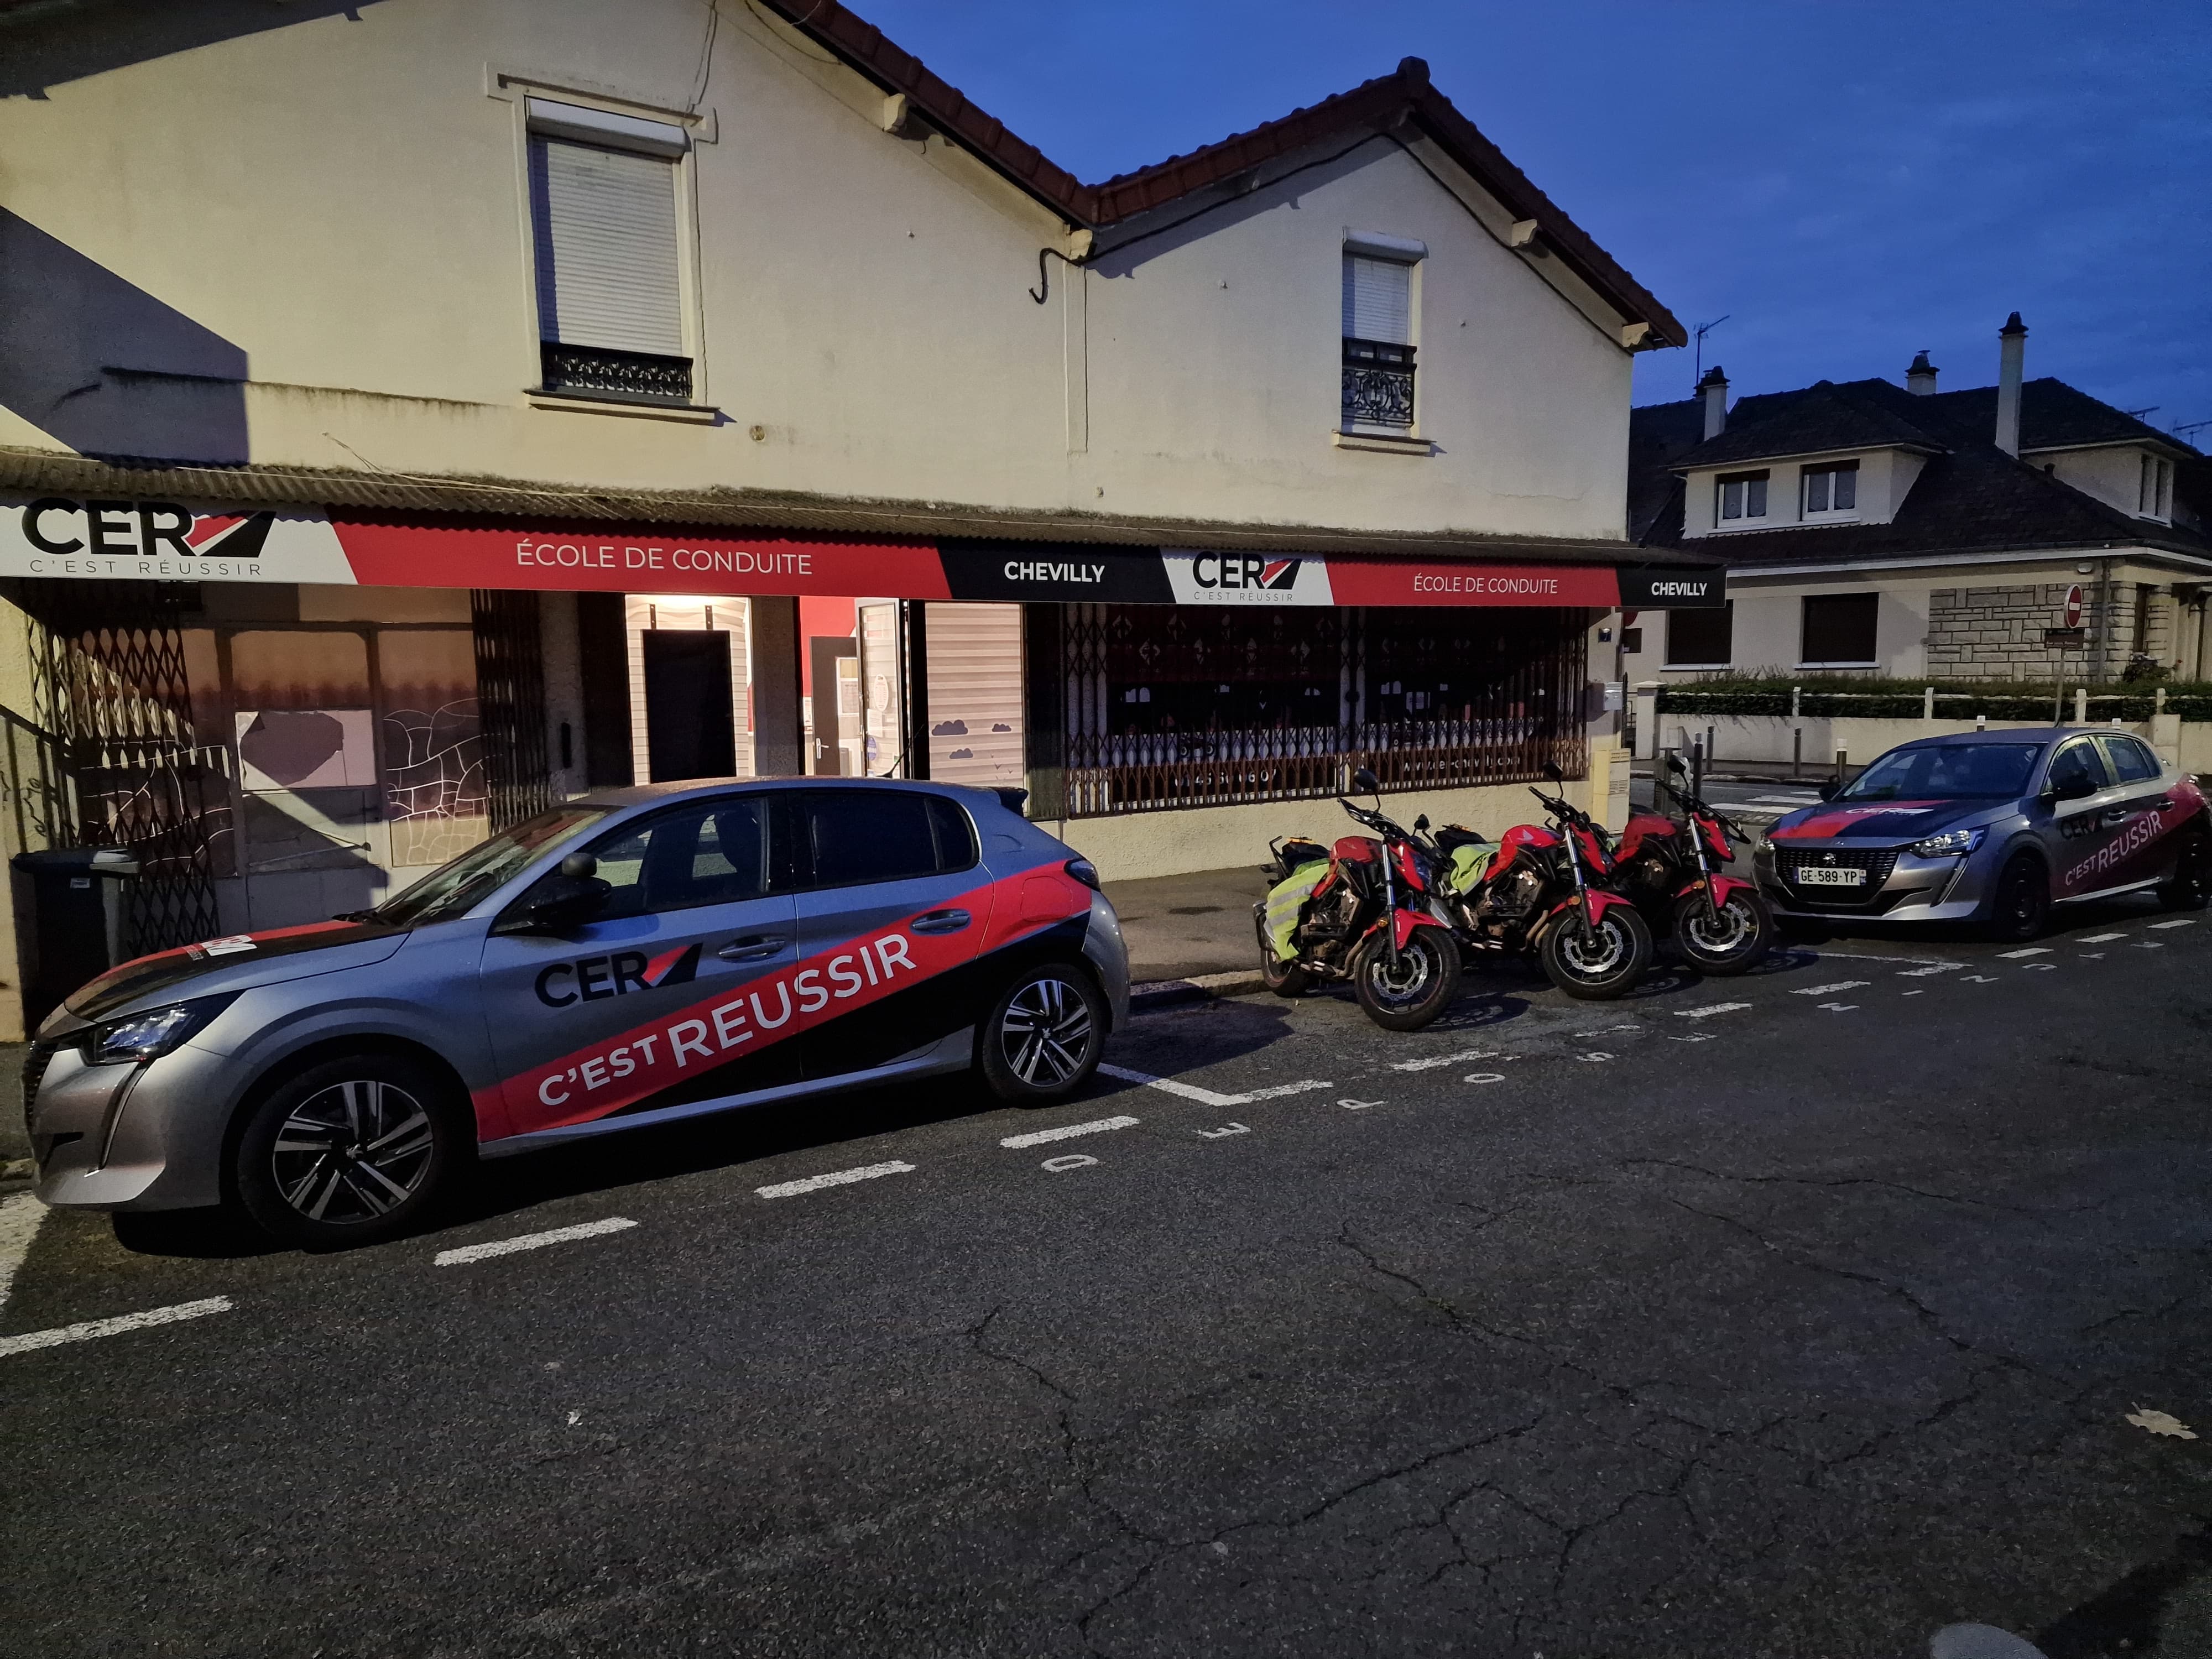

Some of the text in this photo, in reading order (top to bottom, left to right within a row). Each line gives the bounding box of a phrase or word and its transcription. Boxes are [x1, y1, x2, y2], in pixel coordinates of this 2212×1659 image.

[22, 498, 197, 556] CER
[30, 559, 261, 576] C'EST RÉUSSIR
[517, 539, 812, 575] ÉCOLE DE CONDUITE
[1192, 551, 1265, 589] CER
[1004, 561, 1105, 583] CHEVILLY
[1413, 572, 1558, 594] ÉCOLE DE CONDUITE
[1194, 591, 1293, 602] C'EST RÉUSSIR
[1651, 581, 1707, 597] CHEVILLY
[2098, 810, 2163, 873] REUSSIR
[1801, 870, 1857, 883] GE-589-YP
[534, 948, 652, 1008] CER
[538, 933, 917, 1106] C'EST REUSSIR
